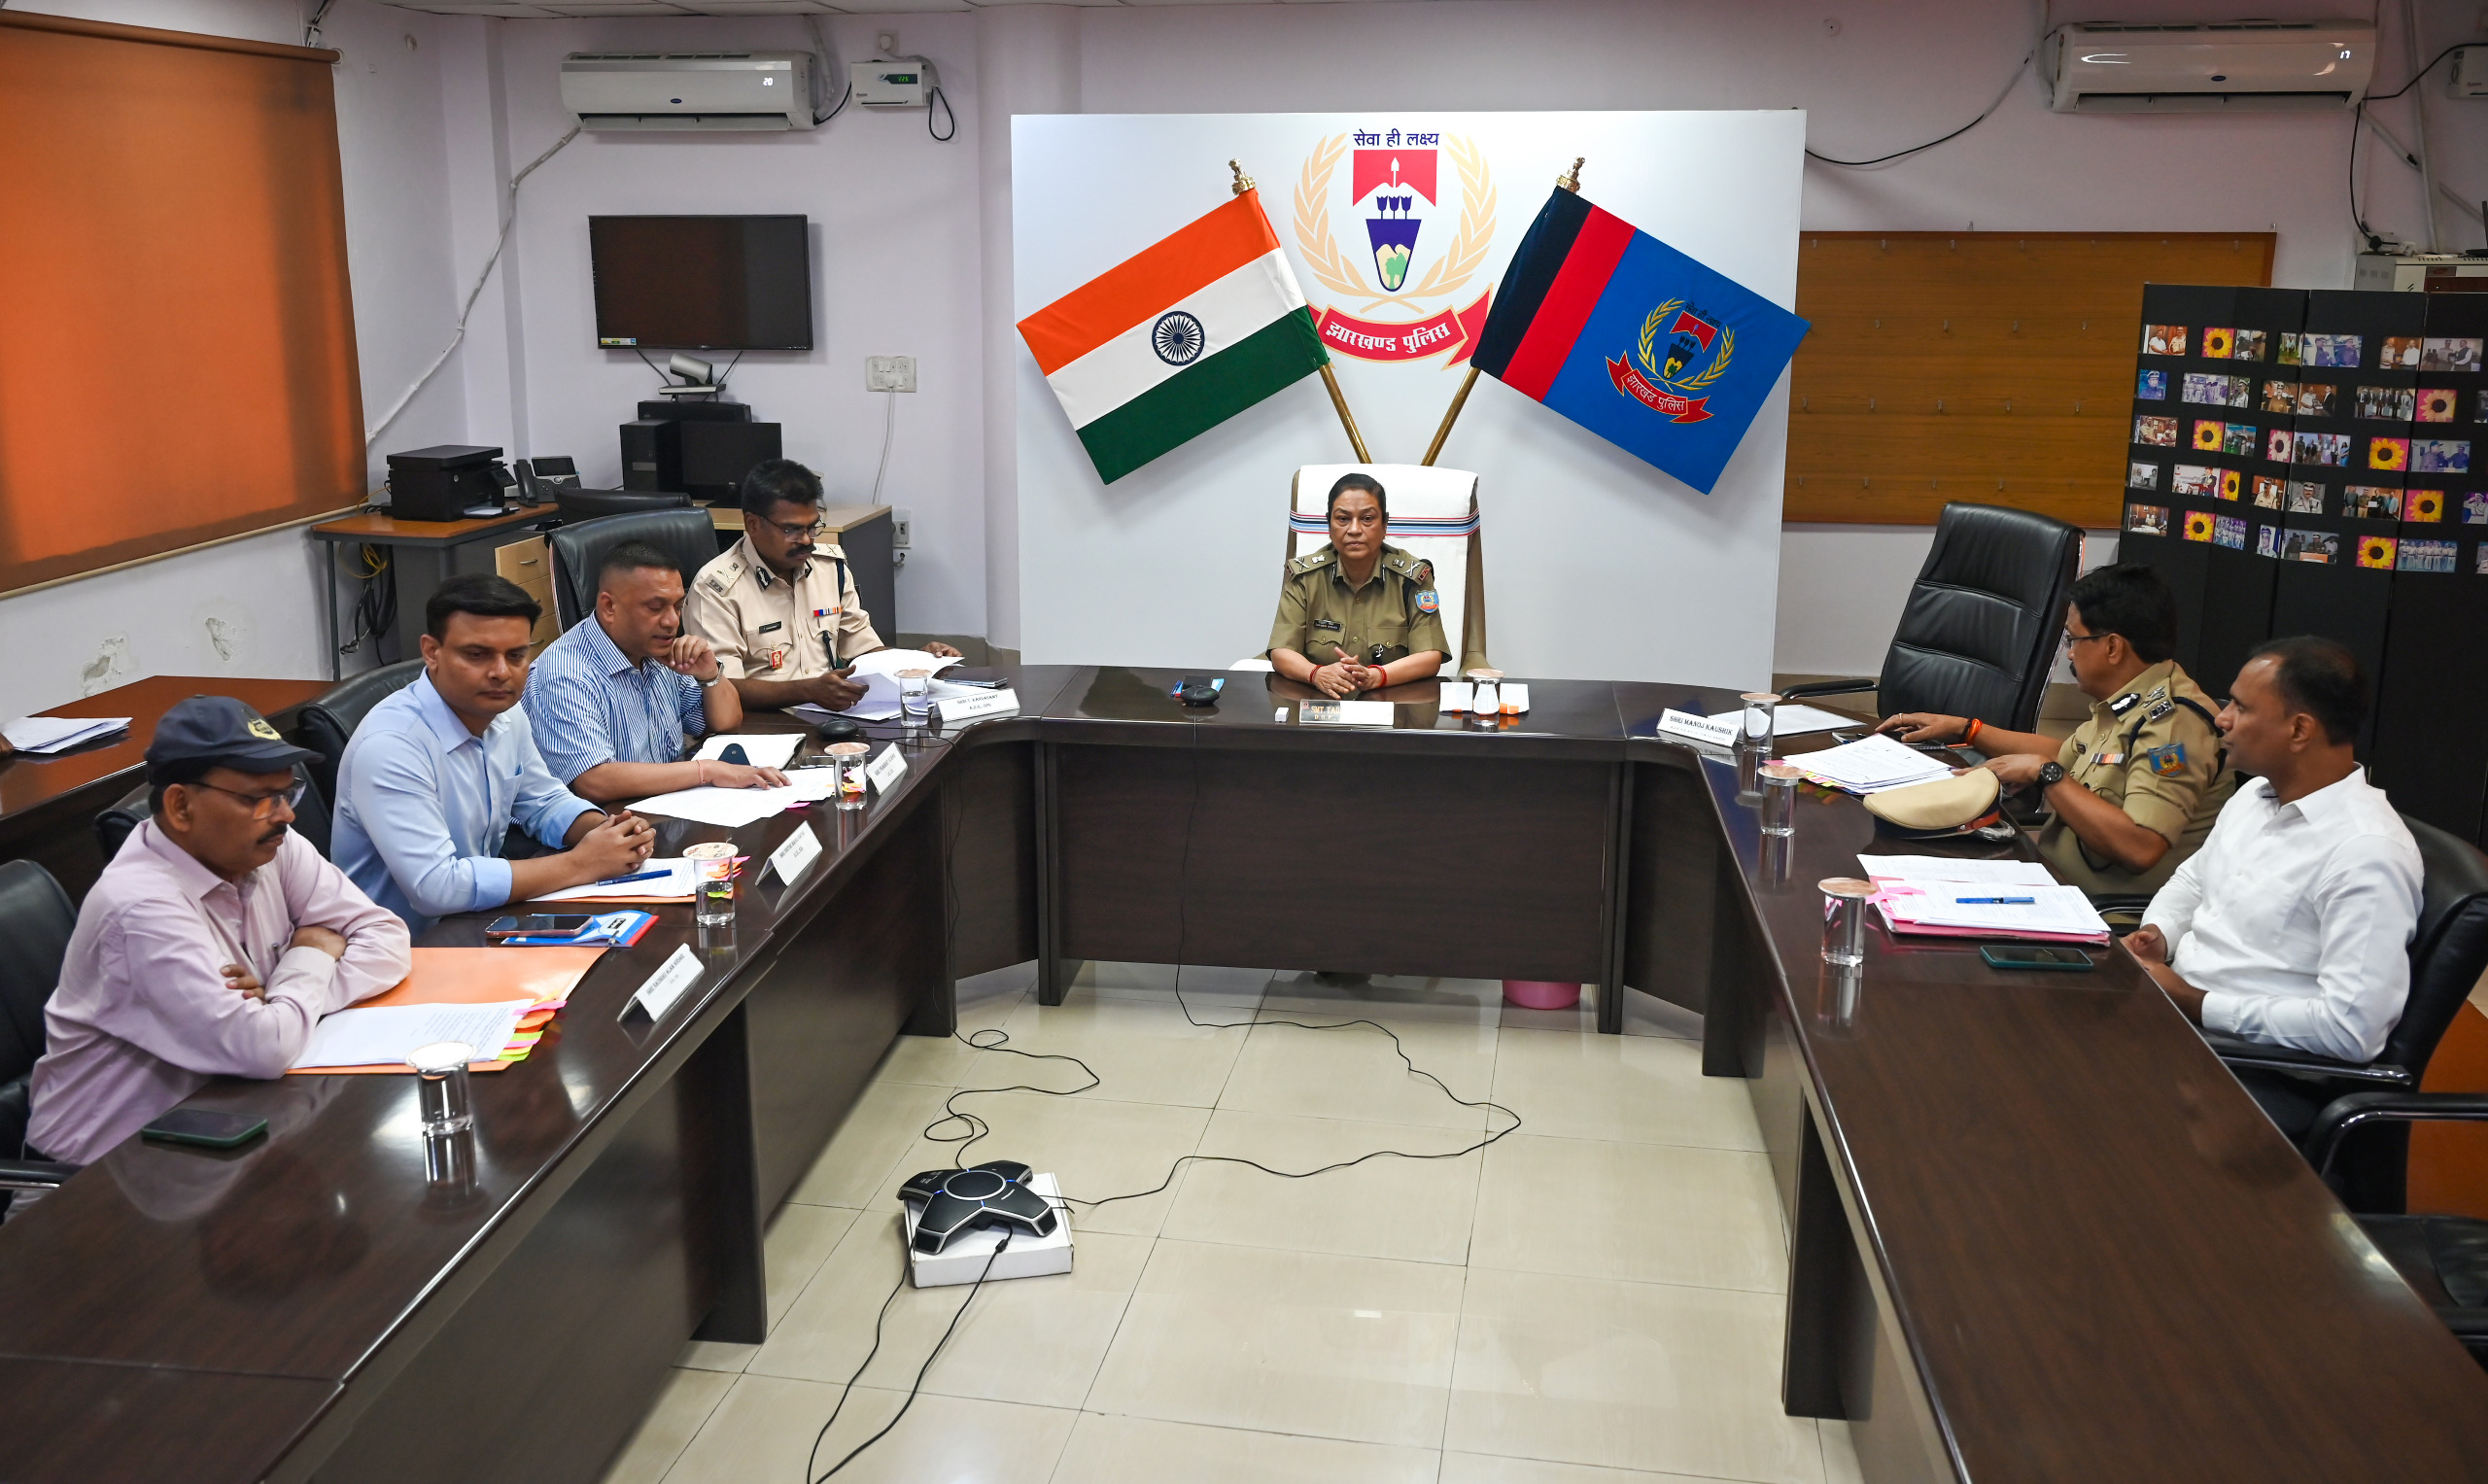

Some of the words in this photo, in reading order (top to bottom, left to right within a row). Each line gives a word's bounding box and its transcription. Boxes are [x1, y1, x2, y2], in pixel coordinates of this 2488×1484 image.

[1353, 128, 1380, 146] सेवा
[1386, 128, 1400, 147] ही
[1406, 133, 1439, 146] लक्ष्य
[1326, 321, 1396, 351] झारखण्ड
[1402, 322, 1450, 354] पुलिस
[1627, 373, 1658, 402] झारखंड
[1656, 396, 1685, 411] पुलिस
[1669, 715, 1683, 724] SHRI
[1684, 718, 1705, 729] MANOJ
[1705, 723, 1734, 736] KAUSHIK
